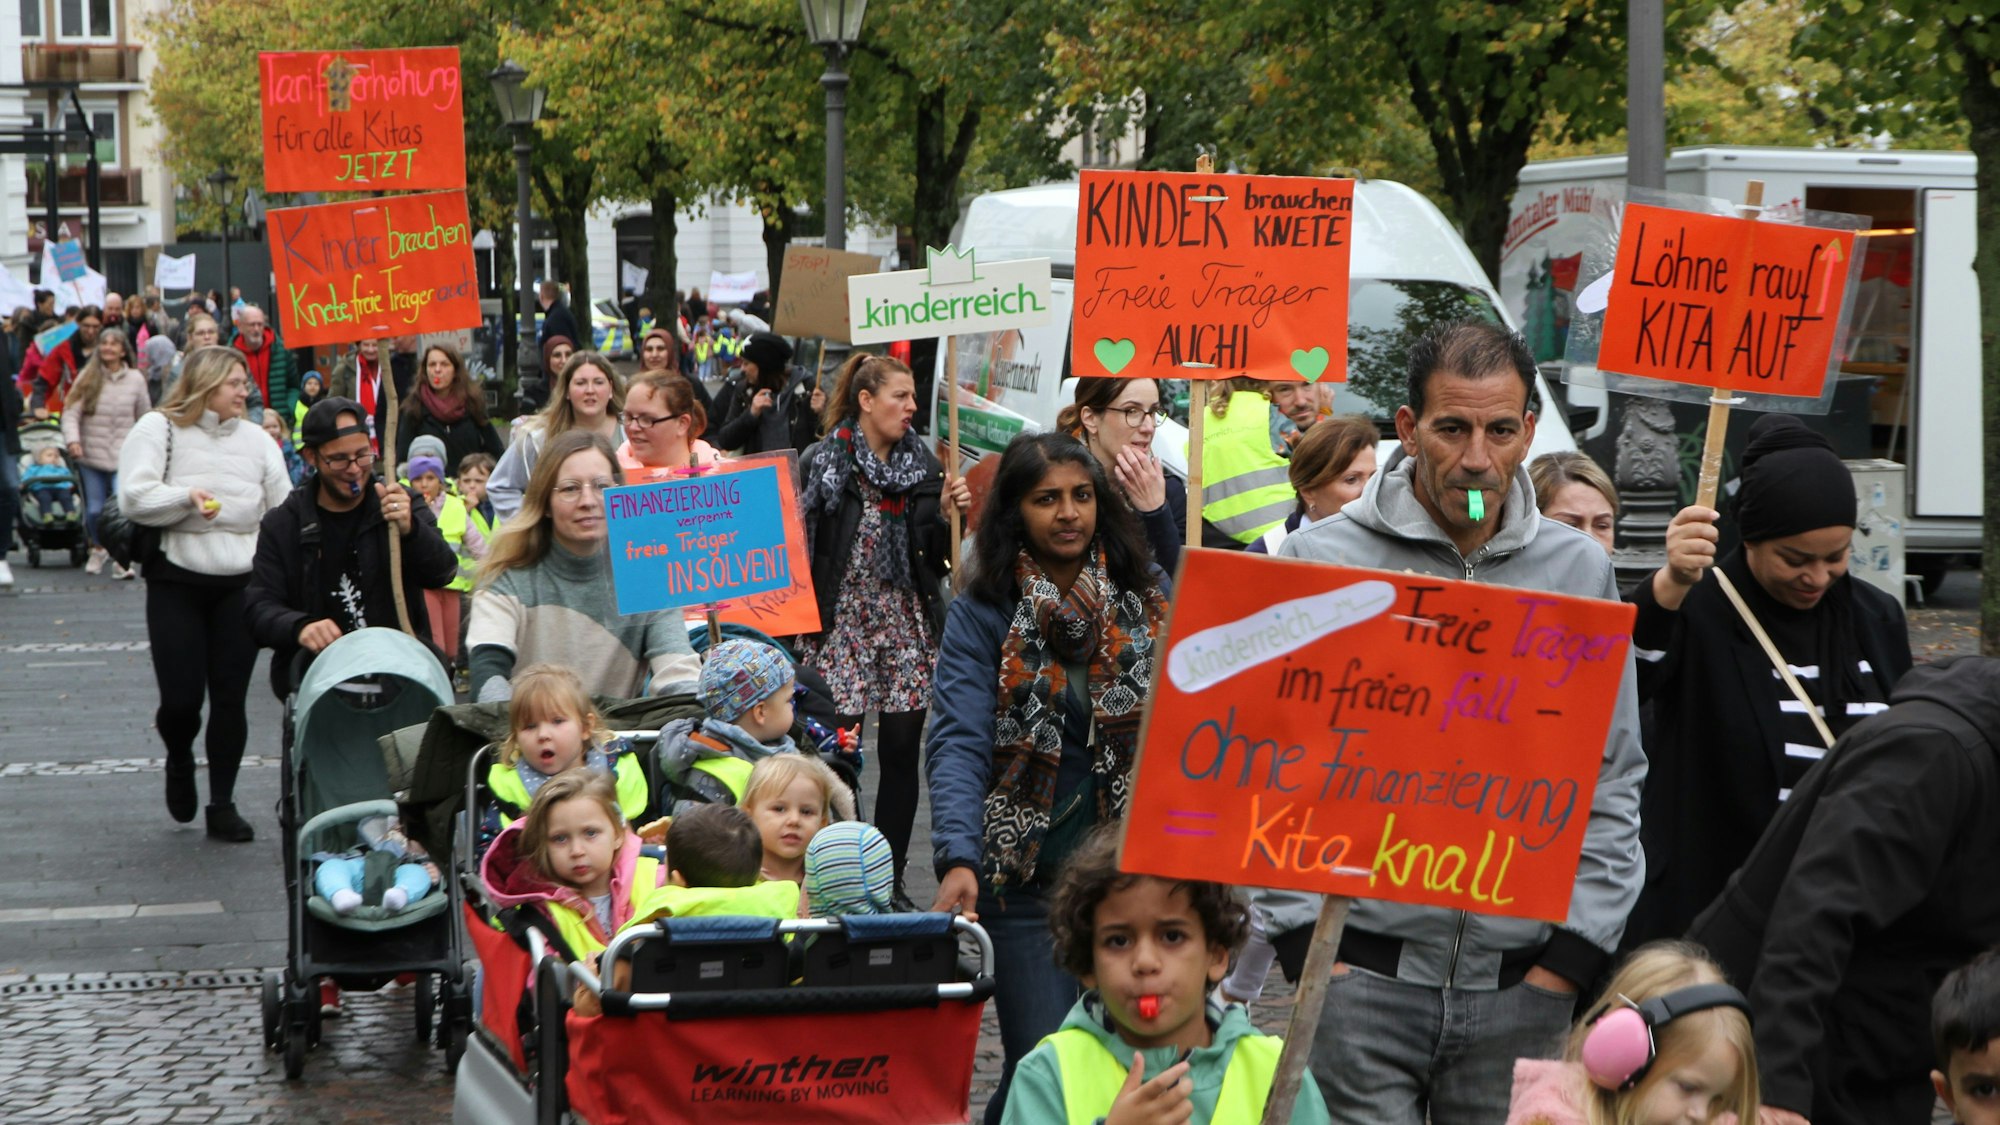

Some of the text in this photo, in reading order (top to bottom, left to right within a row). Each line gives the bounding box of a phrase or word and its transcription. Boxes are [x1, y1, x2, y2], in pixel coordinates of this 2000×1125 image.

[272, 109, 423, 152] für alle Kitas
[335, 148, 418, 181] JETZT
[276, 203, 468, 280] Kinder brauchen
[1085, 179, 1353, 249] KINDER brauchen
[1253, 214, 1347, 248] KNETE
[350, 273, 386, 325] freie
[379, 265, 436, 324] Träger
[857, 282, 1047, 330] kinderreich
[1082, 261, 1329, 329] Freie Träger
[1630, 222, 1823, 331] Löhne rauf
[1635, 297, 1825, 382] KITA AUF
[609, 479, 741, 520] FINANZIERUNG
[676, 508, 734, 530] verpennt
[625, 530, 739, 560] freie Träger
[667, 543, 787, 596] INSOLVENT
[1405, 585, 1632, 688] Freie Träger
[1277, 656, 1323, 703] im
[1328, 657, 1431, 727] freien
[1320, 728, 1578, 851] Finanzierung
[1369, 812, 1515, 905] knall
[691, 1078, 889, 1104] LEARNING BY MOVING
